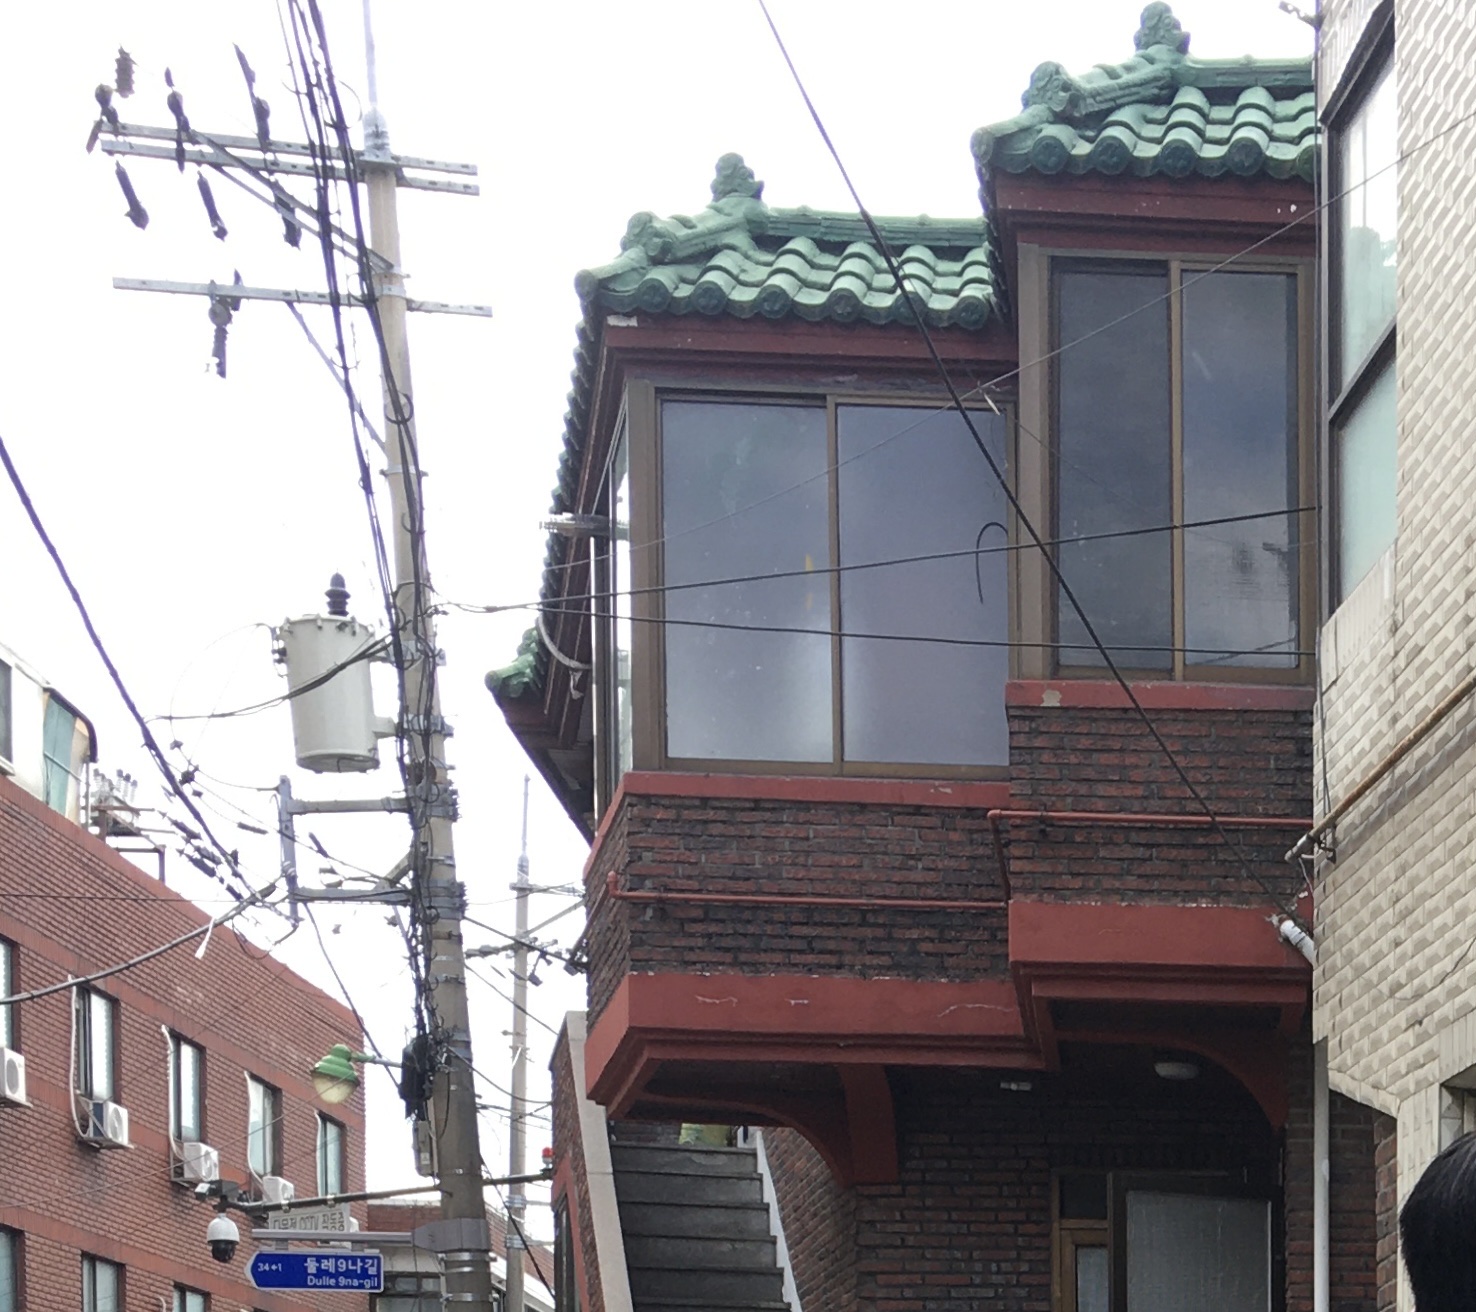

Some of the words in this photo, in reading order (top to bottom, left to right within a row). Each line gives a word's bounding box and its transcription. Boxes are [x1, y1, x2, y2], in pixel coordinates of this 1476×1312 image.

[304, 1257, 378, 1275] 둘레9나길
[307, 1275, 336, 1286] Dulle
[338, 1275, 378, 1288] 9na-gil
